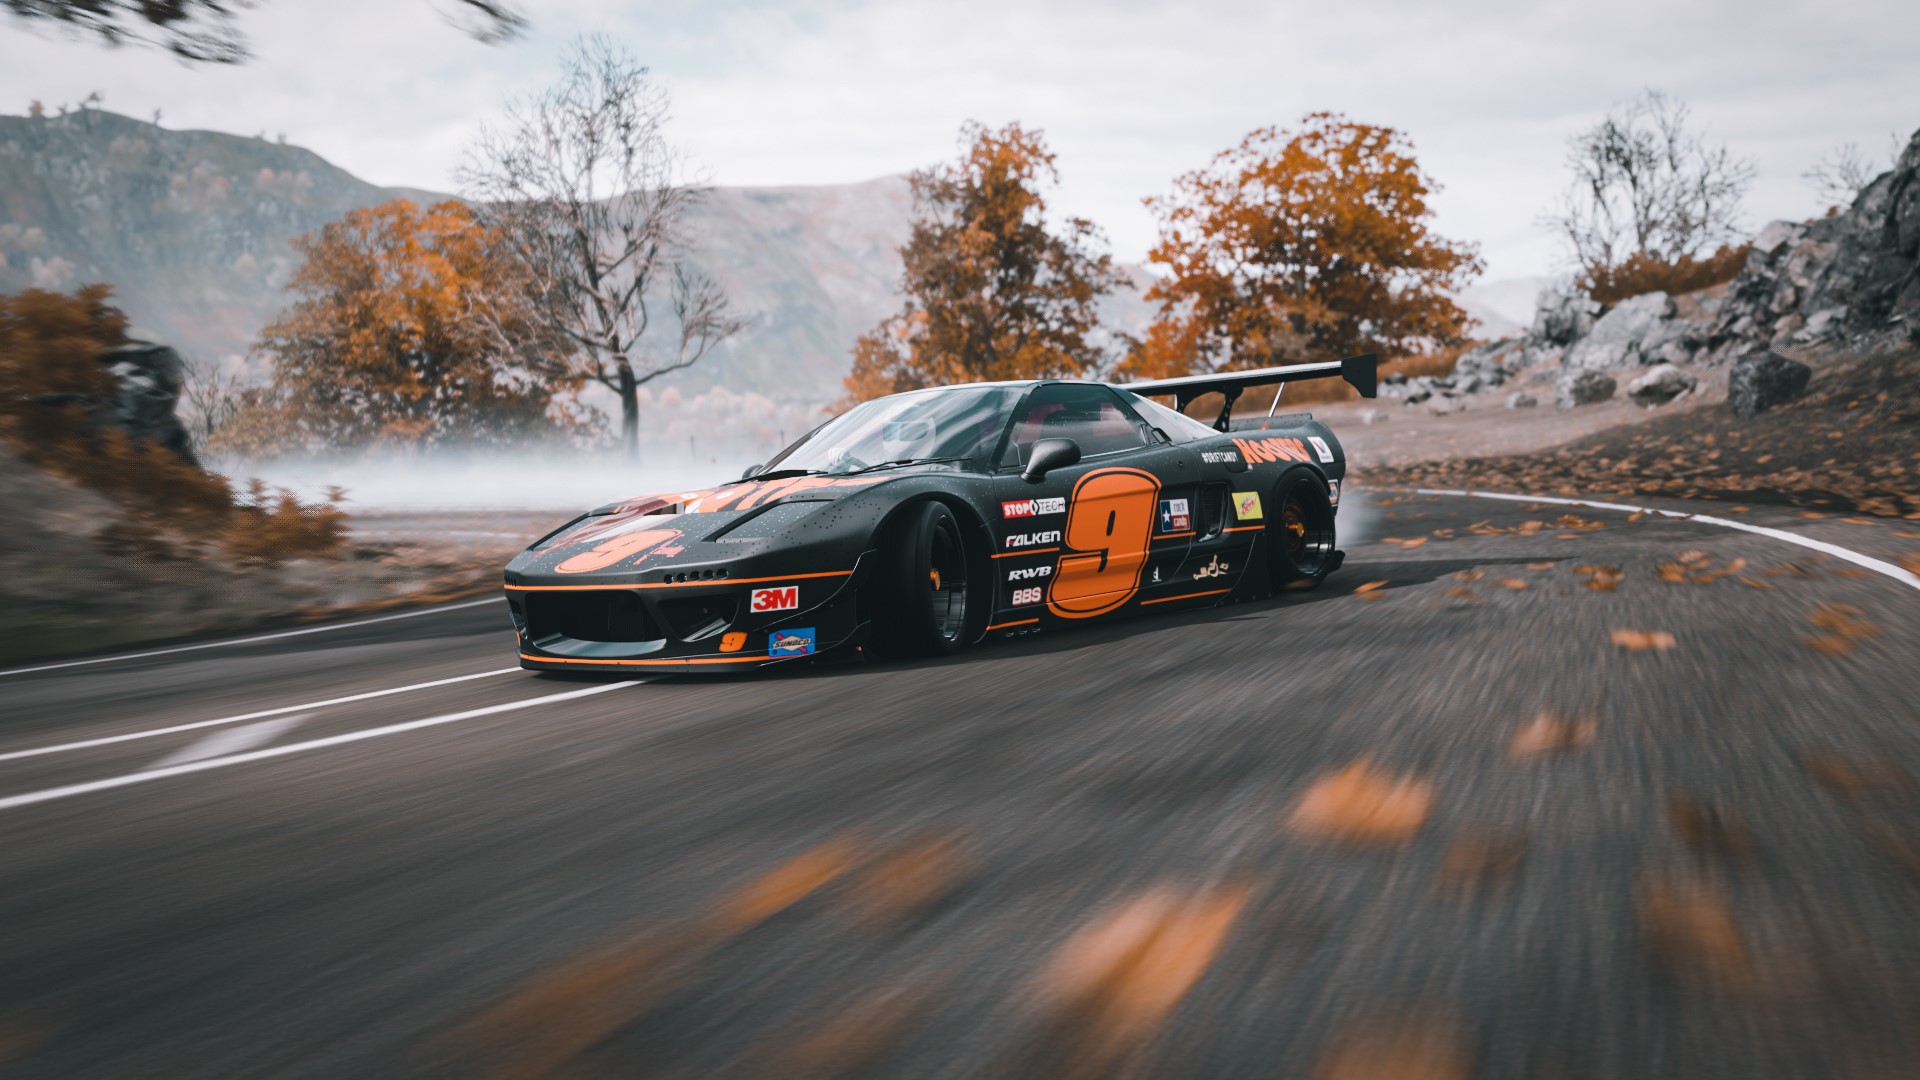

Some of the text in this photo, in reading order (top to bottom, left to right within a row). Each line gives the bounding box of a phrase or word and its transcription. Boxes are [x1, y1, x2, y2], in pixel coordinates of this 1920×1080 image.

[1004, 500, 1064, 516] STOP TECH
[1006, 530, 1060, 548] FALKEN
[1046, 466, 1162, 619] 9
[554, 529, 683, 574] 9
[1008, 566, 1052, 581] RWB
[753, 588, 796, 611] 3M
[1012, 587, 1042, 606] BBS
[719, 631, 748, 652] 9
[774, 638, 811, 648] SUNOCO
